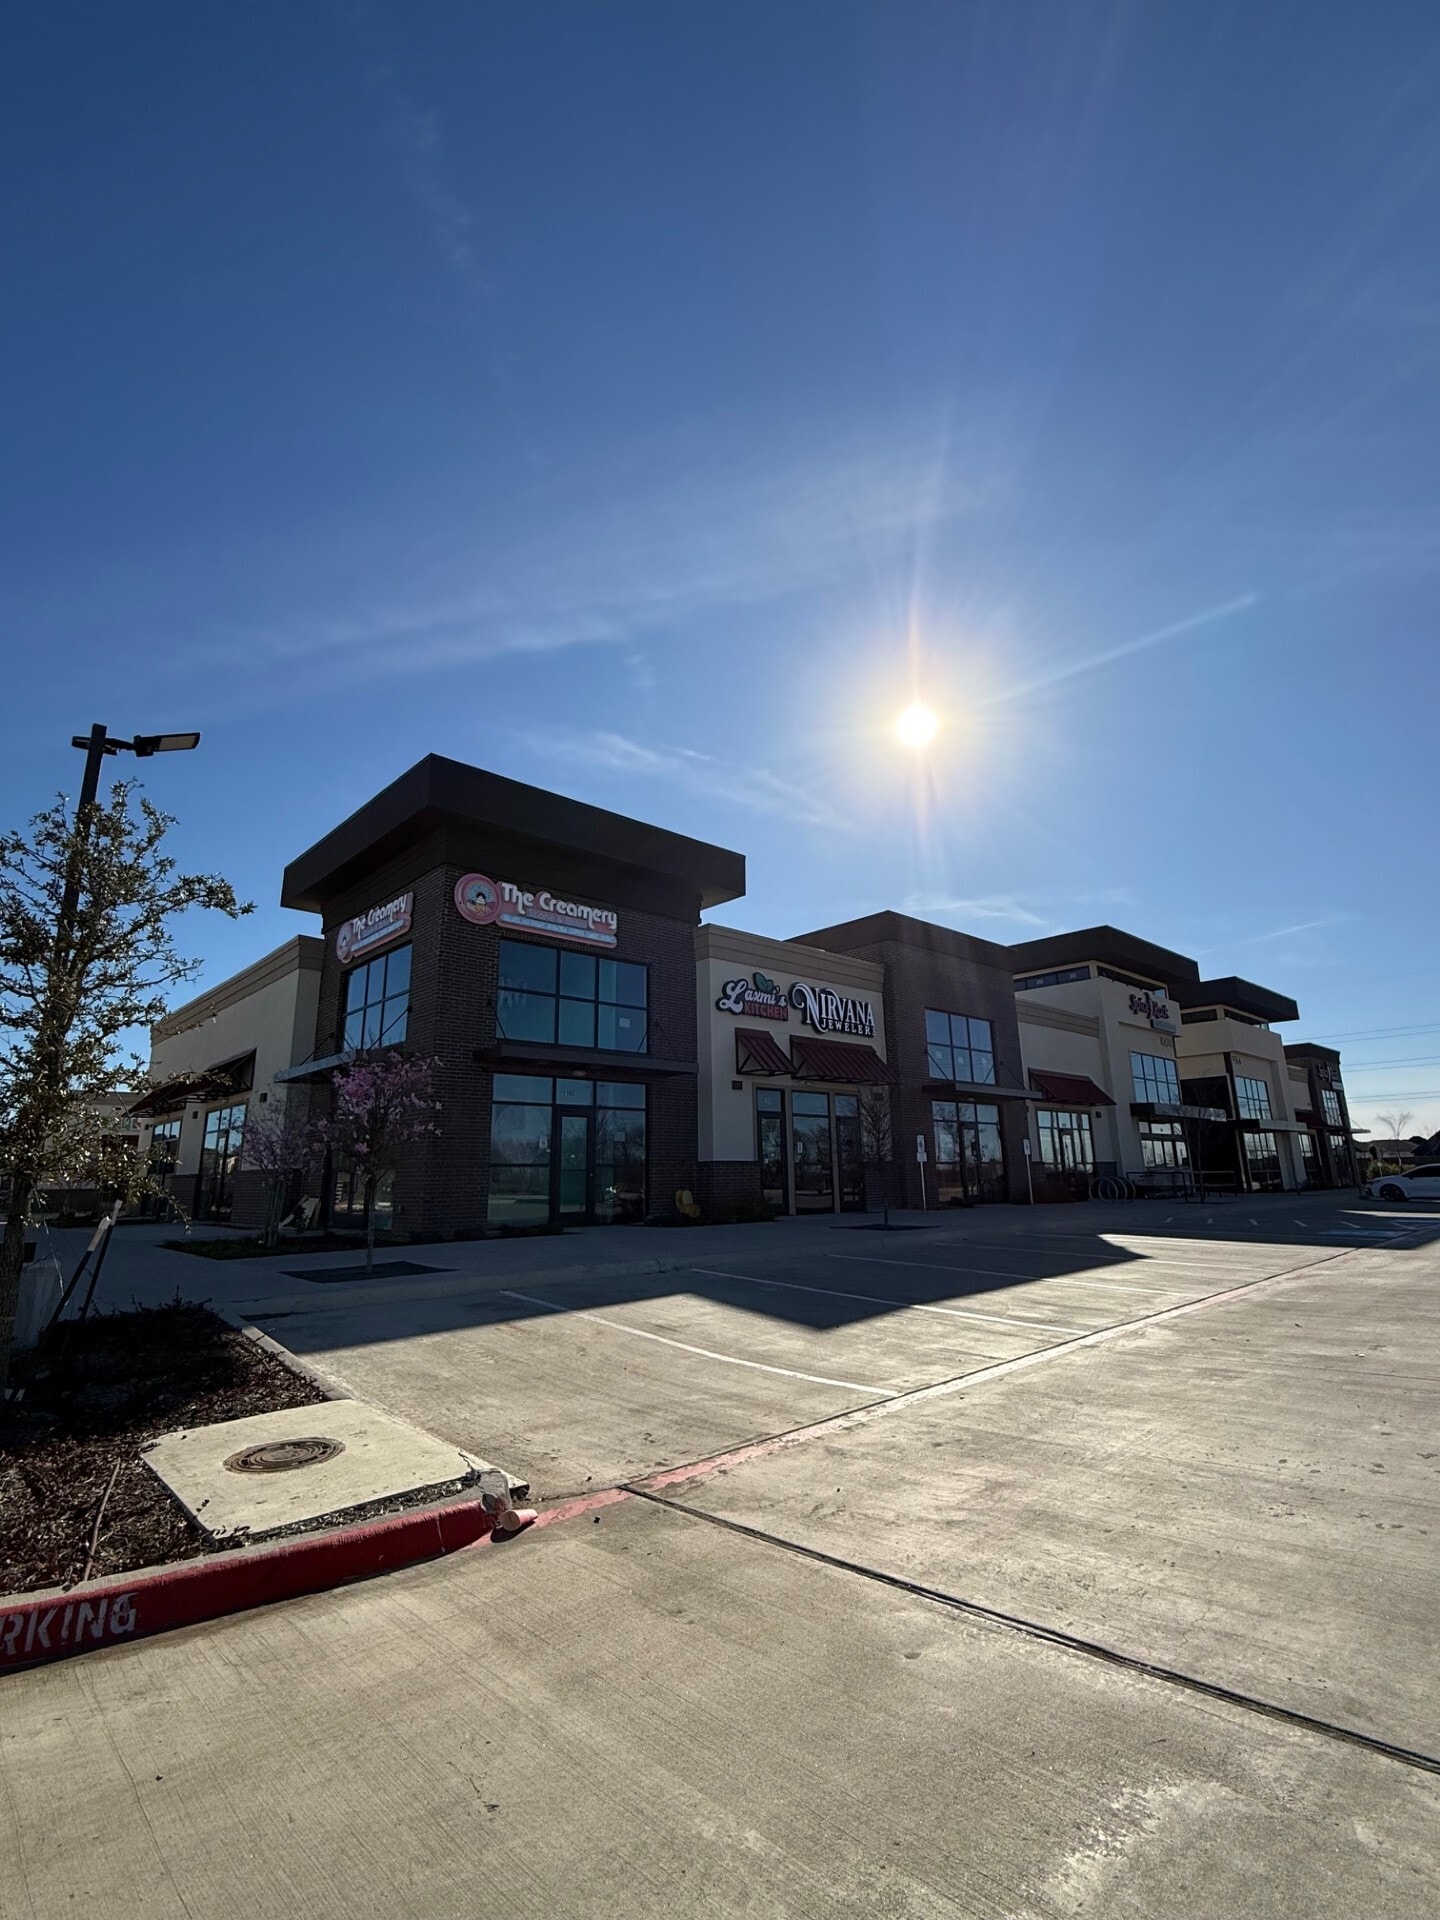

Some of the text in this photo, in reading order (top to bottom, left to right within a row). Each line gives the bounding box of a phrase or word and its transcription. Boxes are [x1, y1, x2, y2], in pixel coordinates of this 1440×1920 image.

[353, 914, 366, 940] The
[367, 893, 407, 926] Creamery
[501, 882, 535, 915] The
[539, 891, 617, 930] Creamery
[718, 979, 788, 1013] Laxmi's
[744, 1002, 788, 1020] KITCHEN
[791, 982, 876, 1032] NIRVANA
[821, 1018, 877, 1037] JEWELERS
